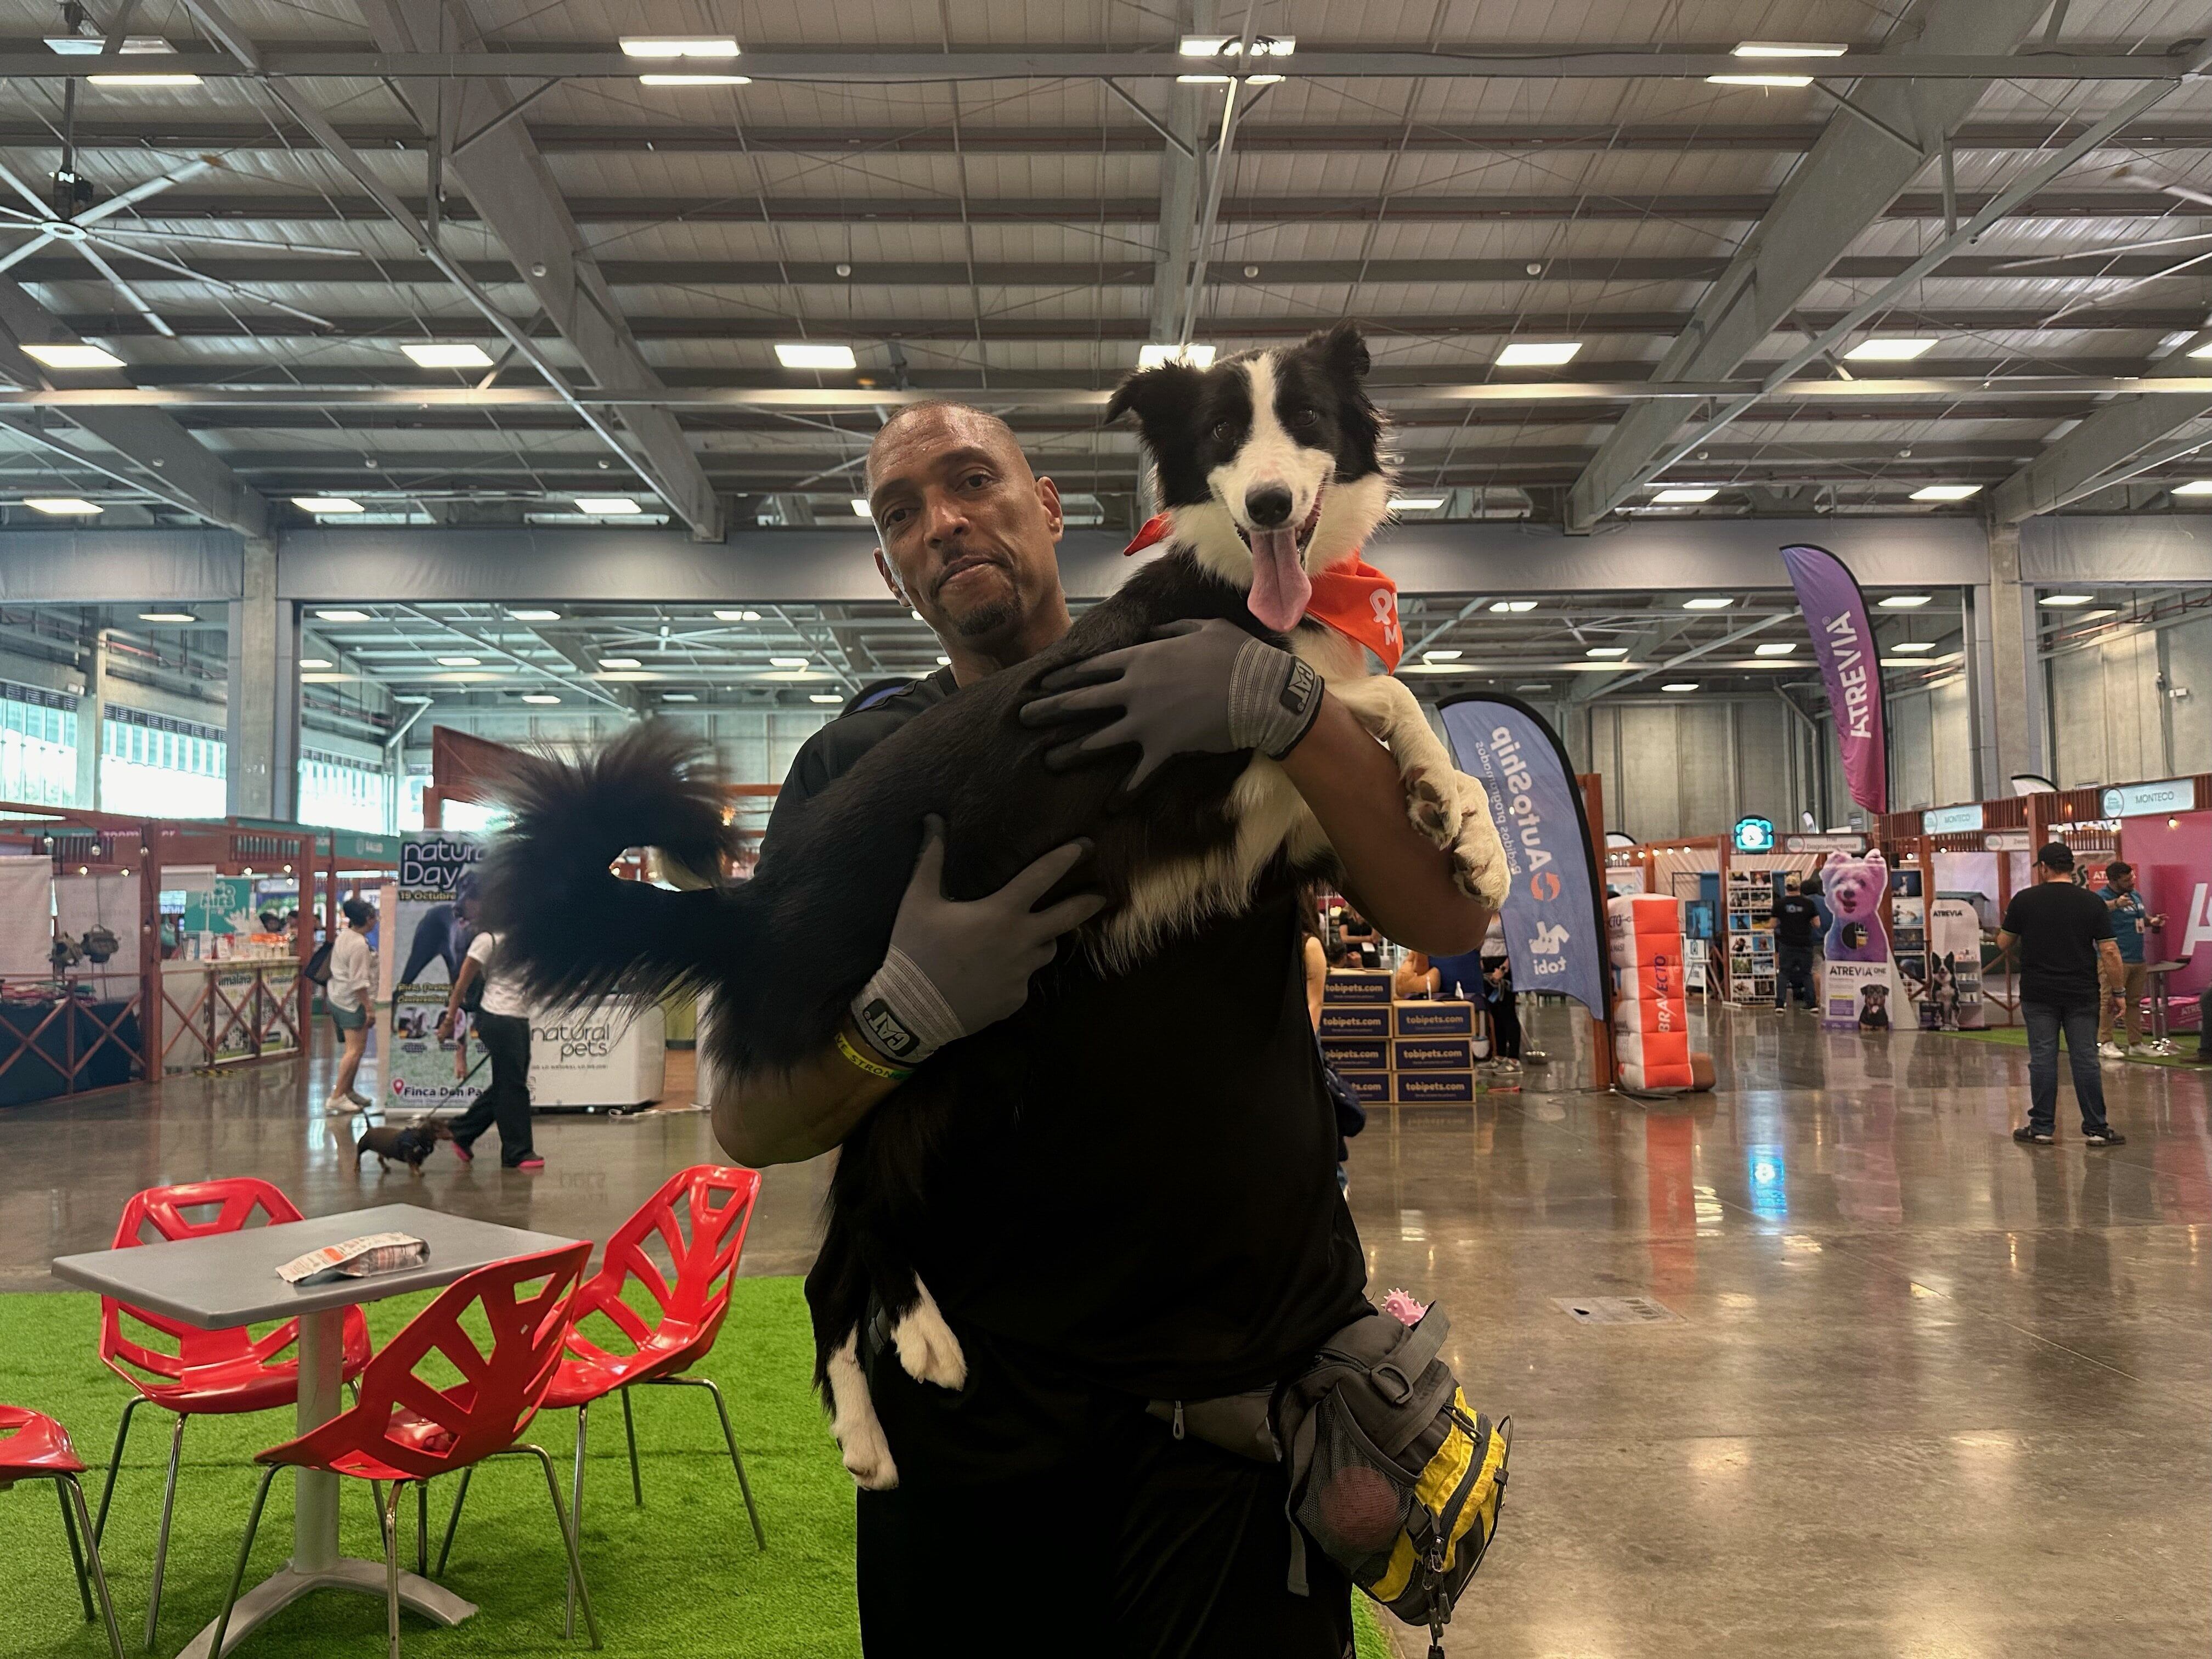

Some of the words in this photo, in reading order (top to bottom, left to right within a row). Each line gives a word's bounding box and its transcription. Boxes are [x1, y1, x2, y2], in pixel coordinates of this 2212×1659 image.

[1826, 610, 1872, 738] ATREVIA
[1287, 661, 1315, 704] CAT
[2136, 791, 2174, 804] MONTECO
[404, 840, 484, 862] natura
[1830, 966, 1872, 976] ATREVIA
[1325, 983, 1384, 994] tobipets.com
[1649, 955, 1675, 1032] BRAVECTO
[1323, 1017, 1381, 1027] tobipets.com
[1406, 1015, 1464, 1025] tobipets.com
[531, 1023, 610, 1041] natural
[868, 1011, 911, 1051] CAT
[561, 1040, 608, 1062] pets
[1325, 1049, 1379, 1060] obipets.com
[1403, 1048, 1463, 1059] tobipets.com
[404, 1086, 436, 1096] Finca
[1406, 1082, 1465, 1092] tobipets.com
